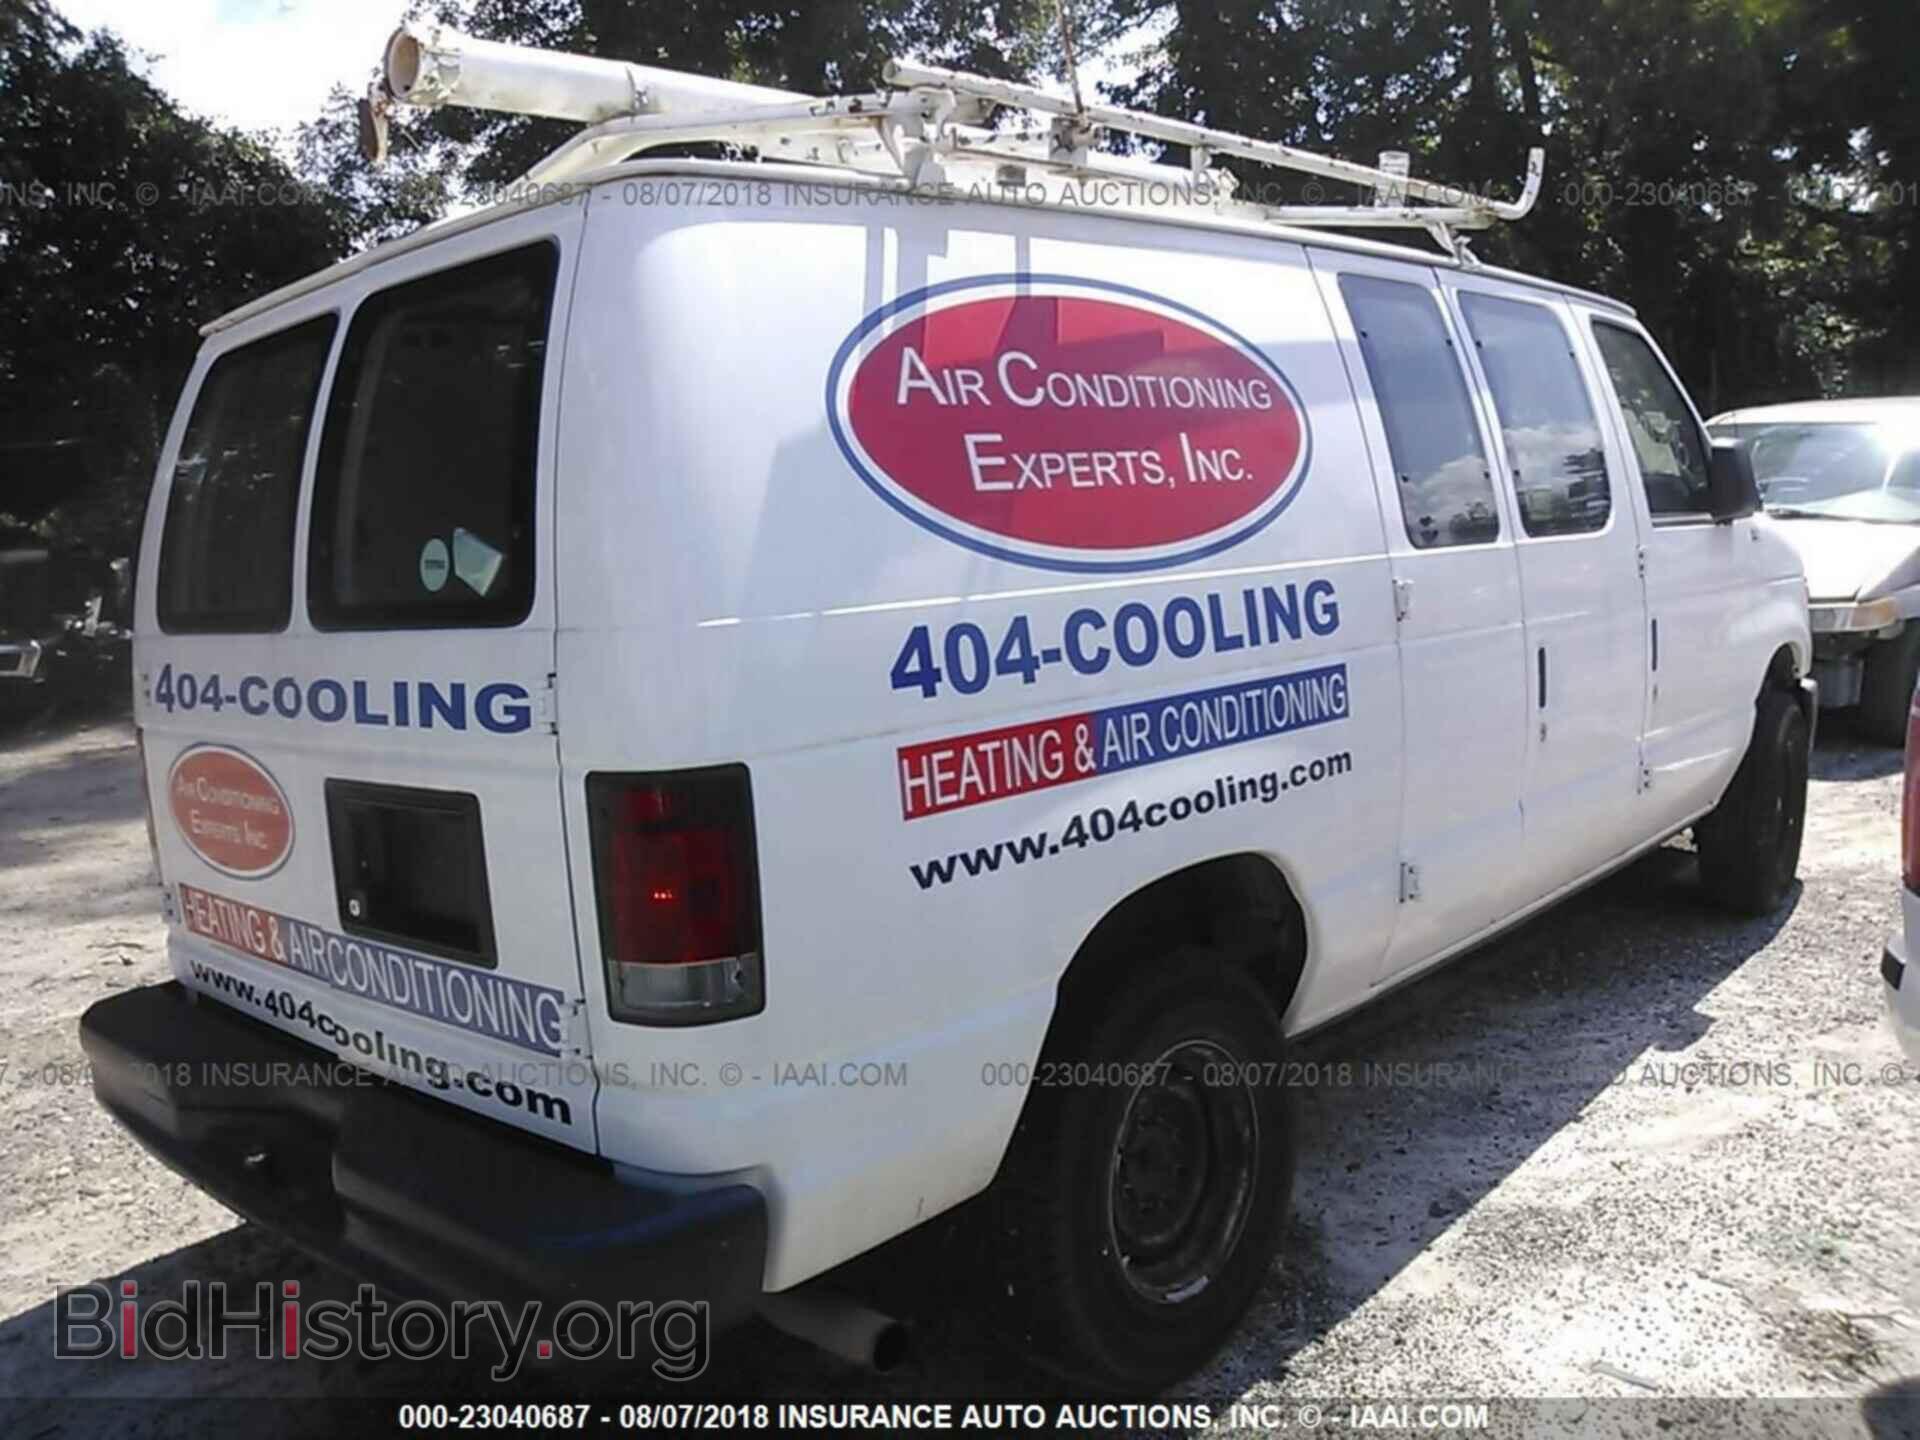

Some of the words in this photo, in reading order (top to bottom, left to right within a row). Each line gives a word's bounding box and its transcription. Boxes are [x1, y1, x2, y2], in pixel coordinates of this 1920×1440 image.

[155, 663, 533, 735] 404-COOLING
[889, 578, 1341, 699] 404-COOLING
[901, 729, 1065, 814] HEATING
[1073, 722, 1097, 774] &
[1101, 711, 1153, 769] AIR
[1160, 671, 1348, 754] CONDITIONING
[909, 750, 1353, 890] www.404cooling.com
[182, 886, 267, 955] HEATING
[267, 914, 287, 962] &
[190, 957, 573, 1125] www.404cooling.com
